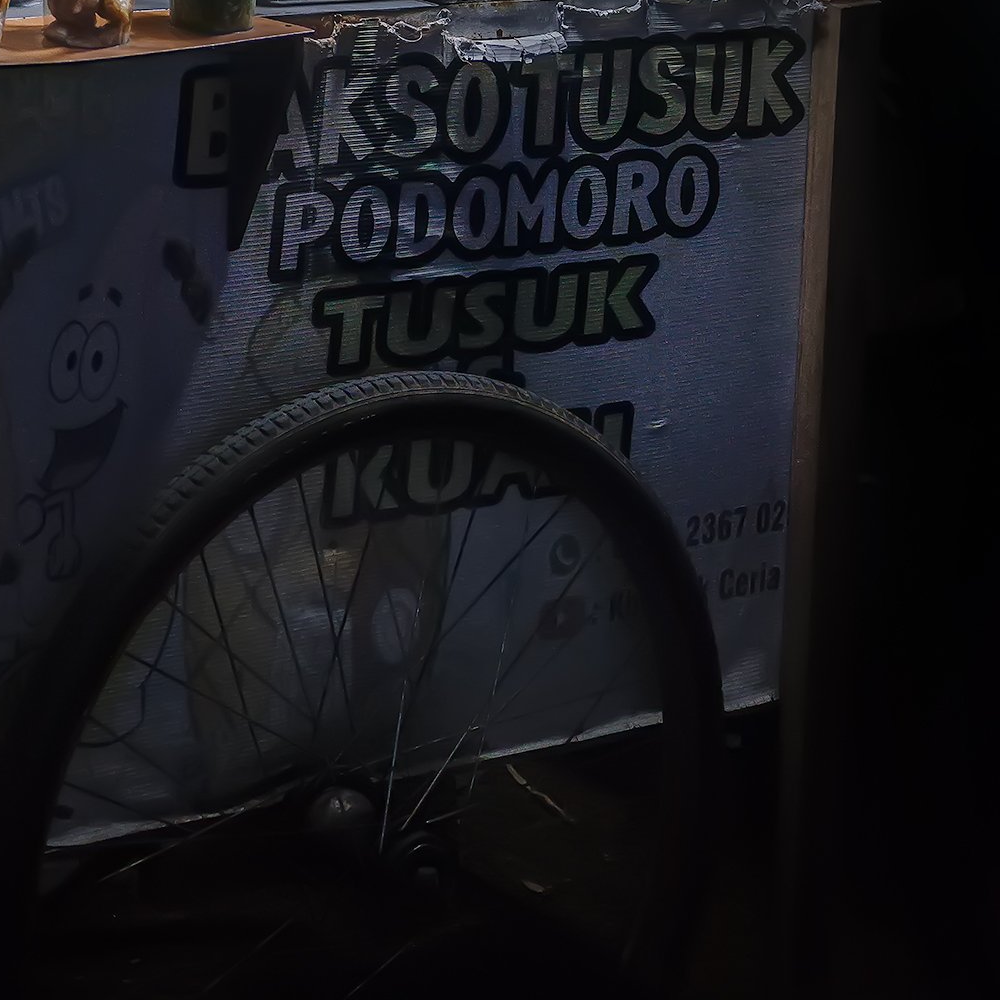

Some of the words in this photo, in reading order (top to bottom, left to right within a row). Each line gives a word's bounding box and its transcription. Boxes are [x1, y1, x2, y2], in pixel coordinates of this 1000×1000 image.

[173, 50, 510, 188] BAKSO
[520, 30, 805, 157] TUSUK
[268, 146, 719, 281] PODOMORO
[313, 254, 657, 375] TUSUK
[686, 505, 748, 547] 2367
[756, 500, 789, 533] 02
[719, 562, 781, 599] Ceria
